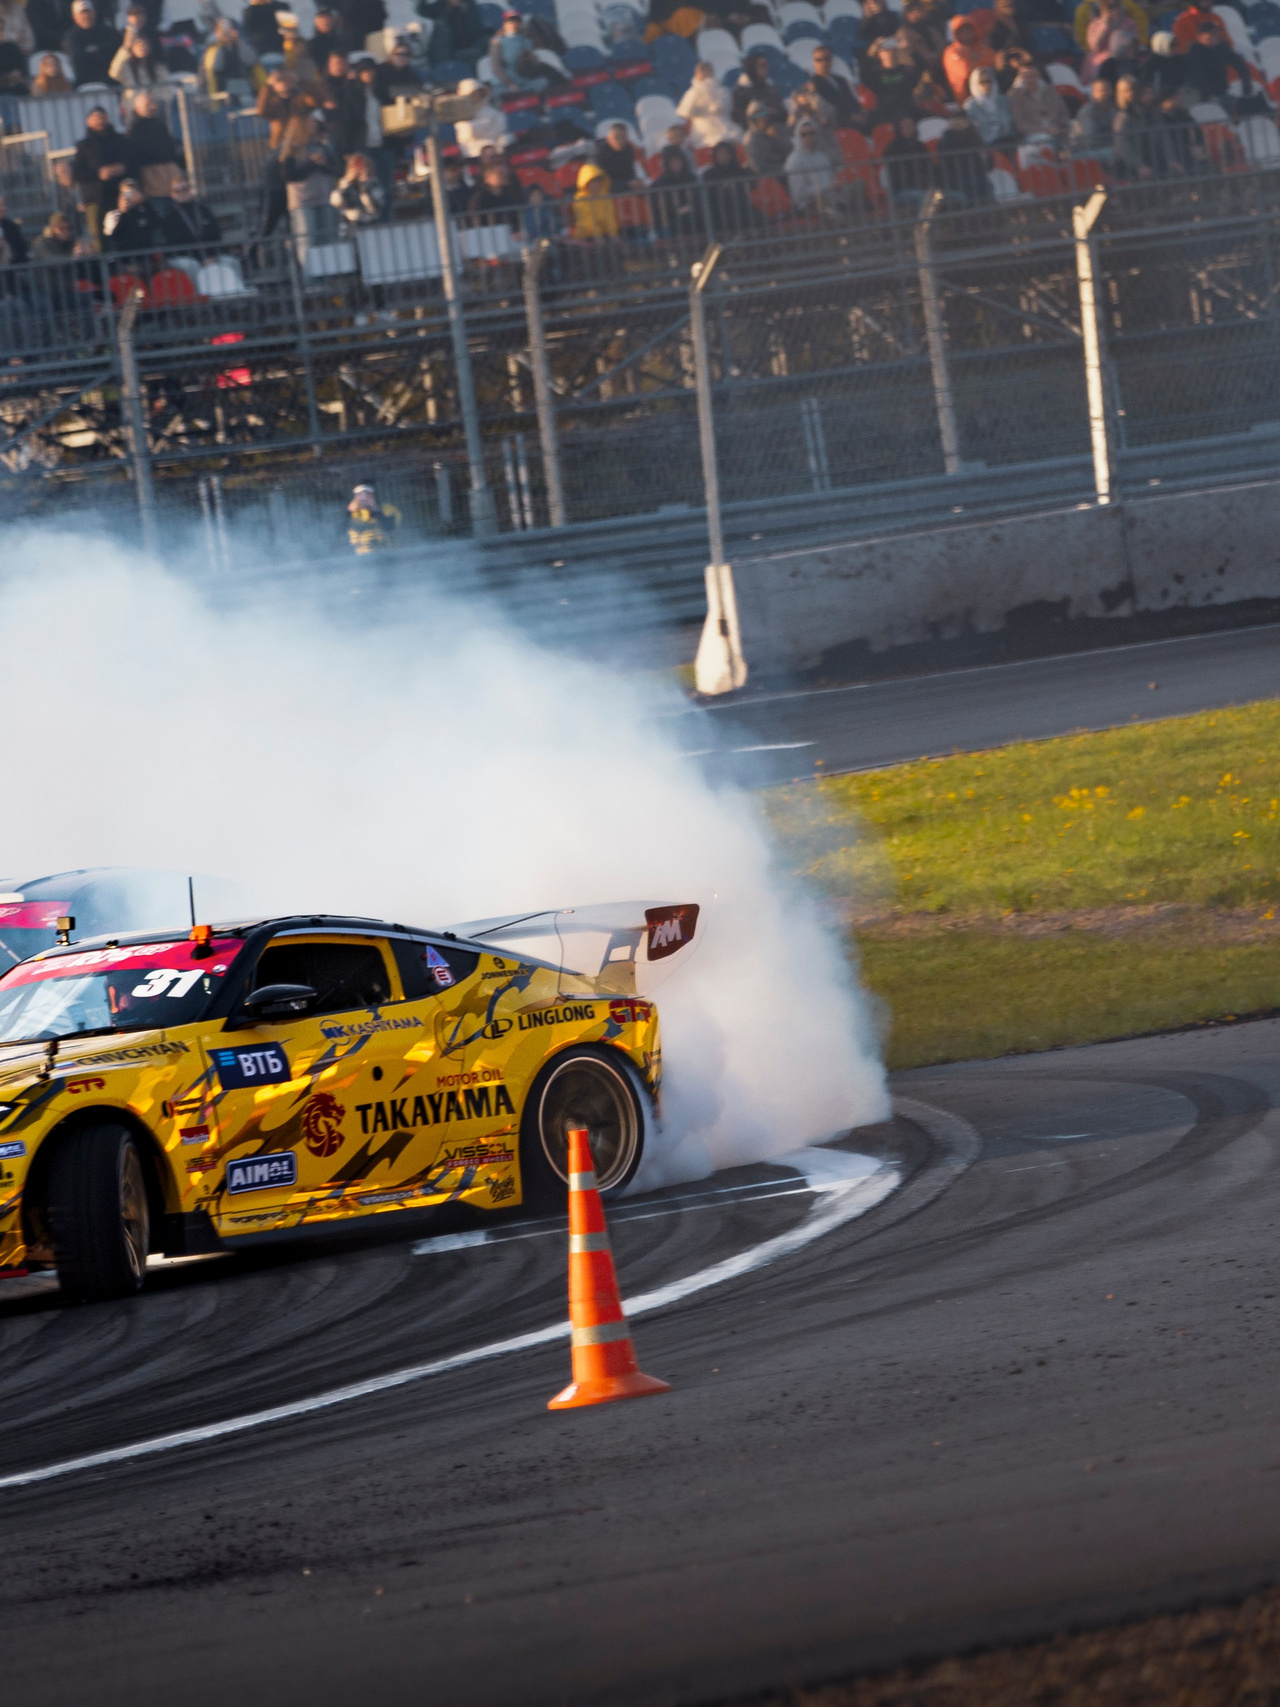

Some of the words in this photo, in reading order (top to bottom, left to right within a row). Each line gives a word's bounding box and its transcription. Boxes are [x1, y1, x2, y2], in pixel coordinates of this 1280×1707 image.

[66, 945, 145, 968] RDS
[131, 968, 205, 998] 31
[349, 1016, 425, 1034] KASHIYAMA
[517, 1004, 596, 1032] LINGLONG
[237, 1050, 283, 1077] ВТБ
[436, 1072, 480, 1088] MOTOR
[481, 1069, 505, 1082] OIL
[355, 1084, 516, 1134] TAKAYAMA
[444, 1142, 515, 1159] VISSOL
